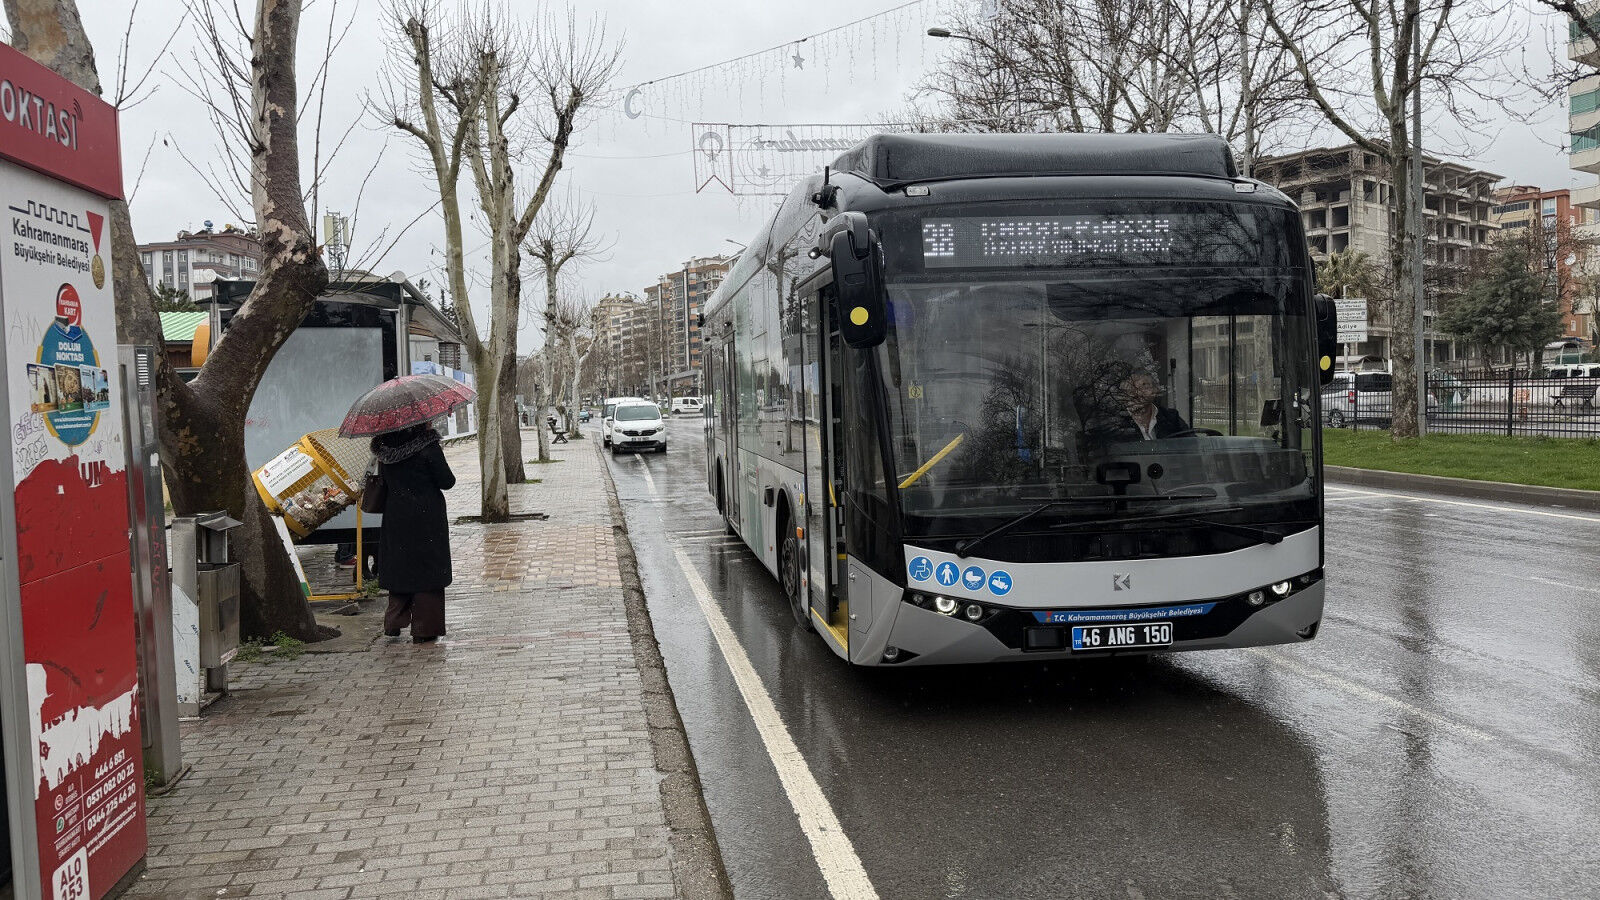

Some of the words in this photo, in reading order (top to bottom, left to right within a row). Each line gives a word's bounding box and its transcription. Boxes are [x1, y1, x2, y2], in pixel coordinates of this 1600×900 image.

[12, 217, 89, 258] Kahramanmaraş
[14, 242, 56, 266] Büyükşehir
[56, 252, 91, 274] Belediyesi
[64, 307, 77, 316] KART
[56, 352, 84, 362] NOKTASI
[58, 342, 81, 352] DOLUM
[1054, 614, 1066, 622] T.C.
[1068, 613, 1127, 622] Kahramanmaraş
[1129, 609, 1167, 620] Büyükşehir
[1168, 606, 1204, 617] Belediyesi
[1082, 628, 1100, 646] 46
[1108, 627, 1135, 645] ANG
[1143, 625, 1170, 643] 150
[95, 761, 108, 779] 444
[109, 757, 114, 770] 6
[114, 748, 125, 766] 851
[87, 786, 103, 808] 0531
[103, 776, 116, 795] 082
[116, 769, 126, 784] 00
[126, 762, 135, 777] 22
[87, 808, 105, 831] 0344
[105, 796, 118, 816] 225
[127, 782, 136, 798] 20
[60, 857, 82, 890] ALO
